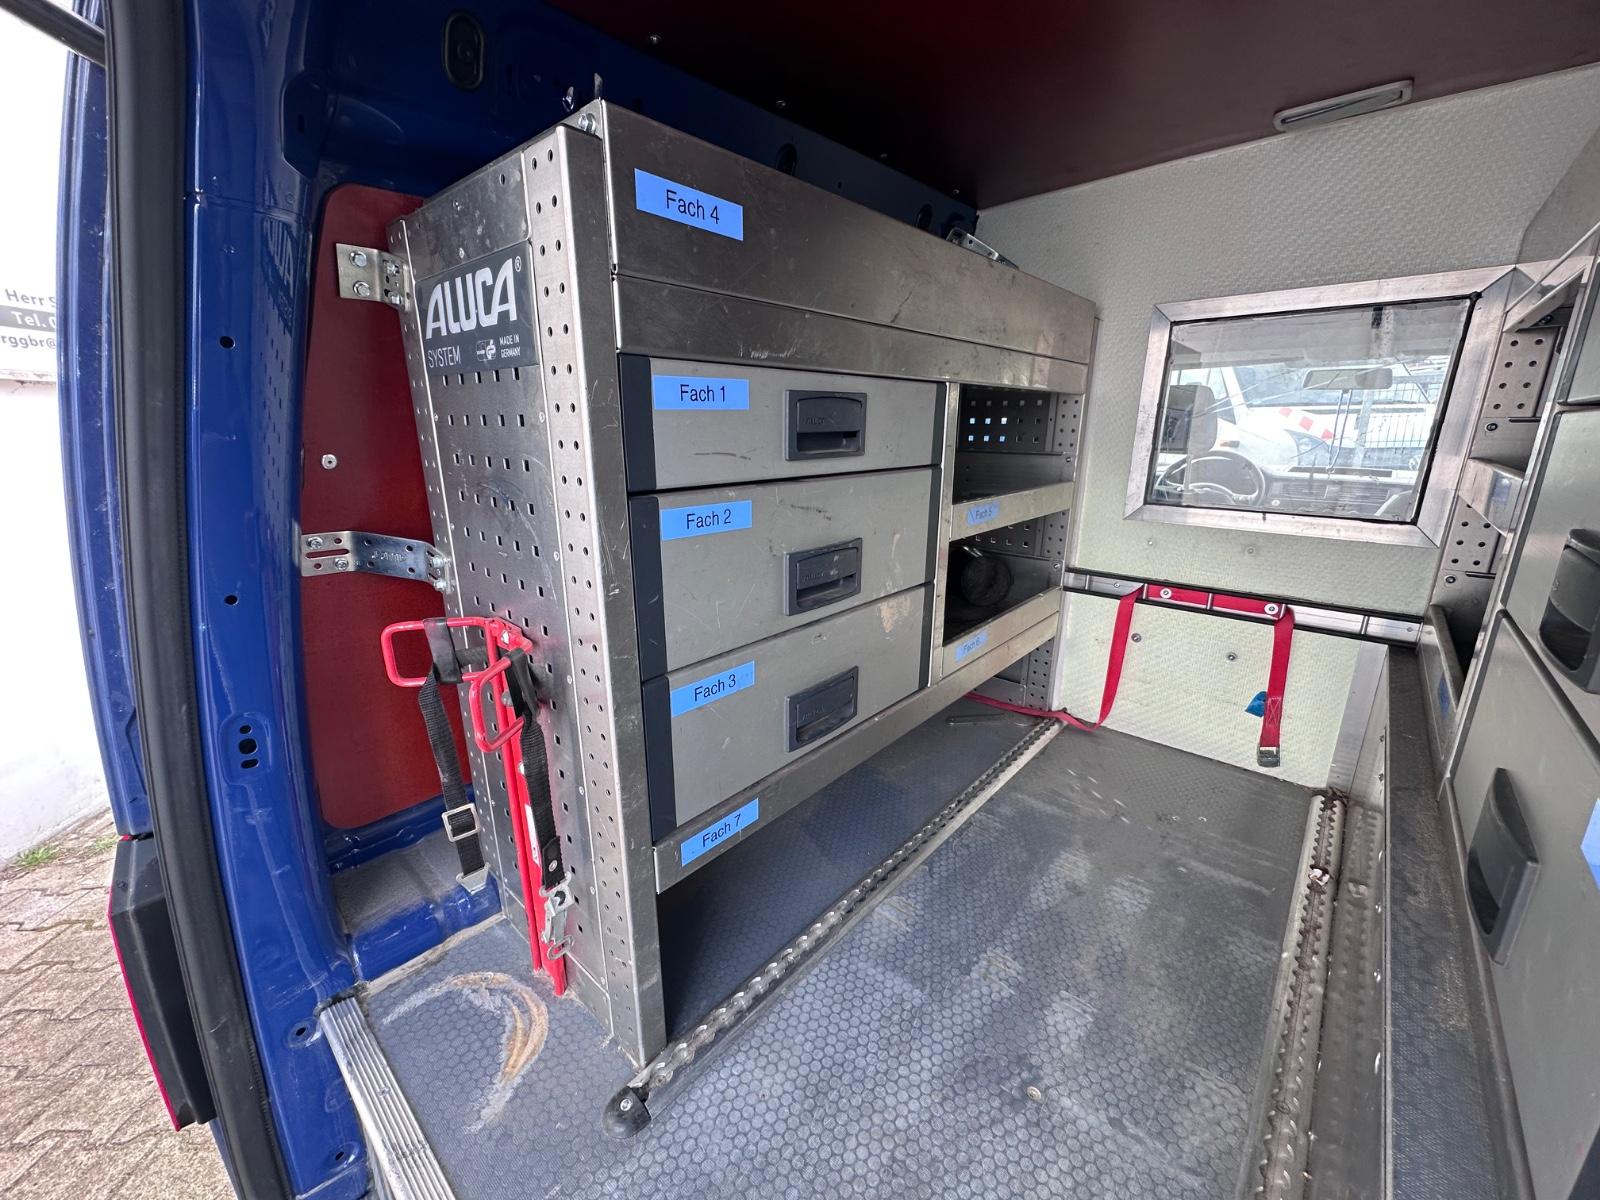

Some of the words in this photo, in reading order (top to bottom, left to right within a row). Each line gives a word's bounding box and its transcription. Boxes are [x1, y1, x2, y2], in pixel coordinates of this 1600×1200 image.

[665, 188, 705, 221] Fach
[710, 205, 720, 225] 4
[4, 288, 45, 306] Herr
[10, 310, 47, 328] Tel.
[499, 334, 514, 346] MADE
[513, 333, 520, 344] IN
[427, 344, 462, 369] SYSTEM
[500, 346, 521, 358] GERMANY
[680, 383, 715, 403] Fach
[720, 385, 726, 403] 1
[686, 510, 720, 530] Fach
[723, 508, 732, 524] 2
[694, 679, 725, 702] Fach
[728, 673, 737, 688] 3
[702, 822, 732, 848] Fach
[733, 813, 742, 828] 7
